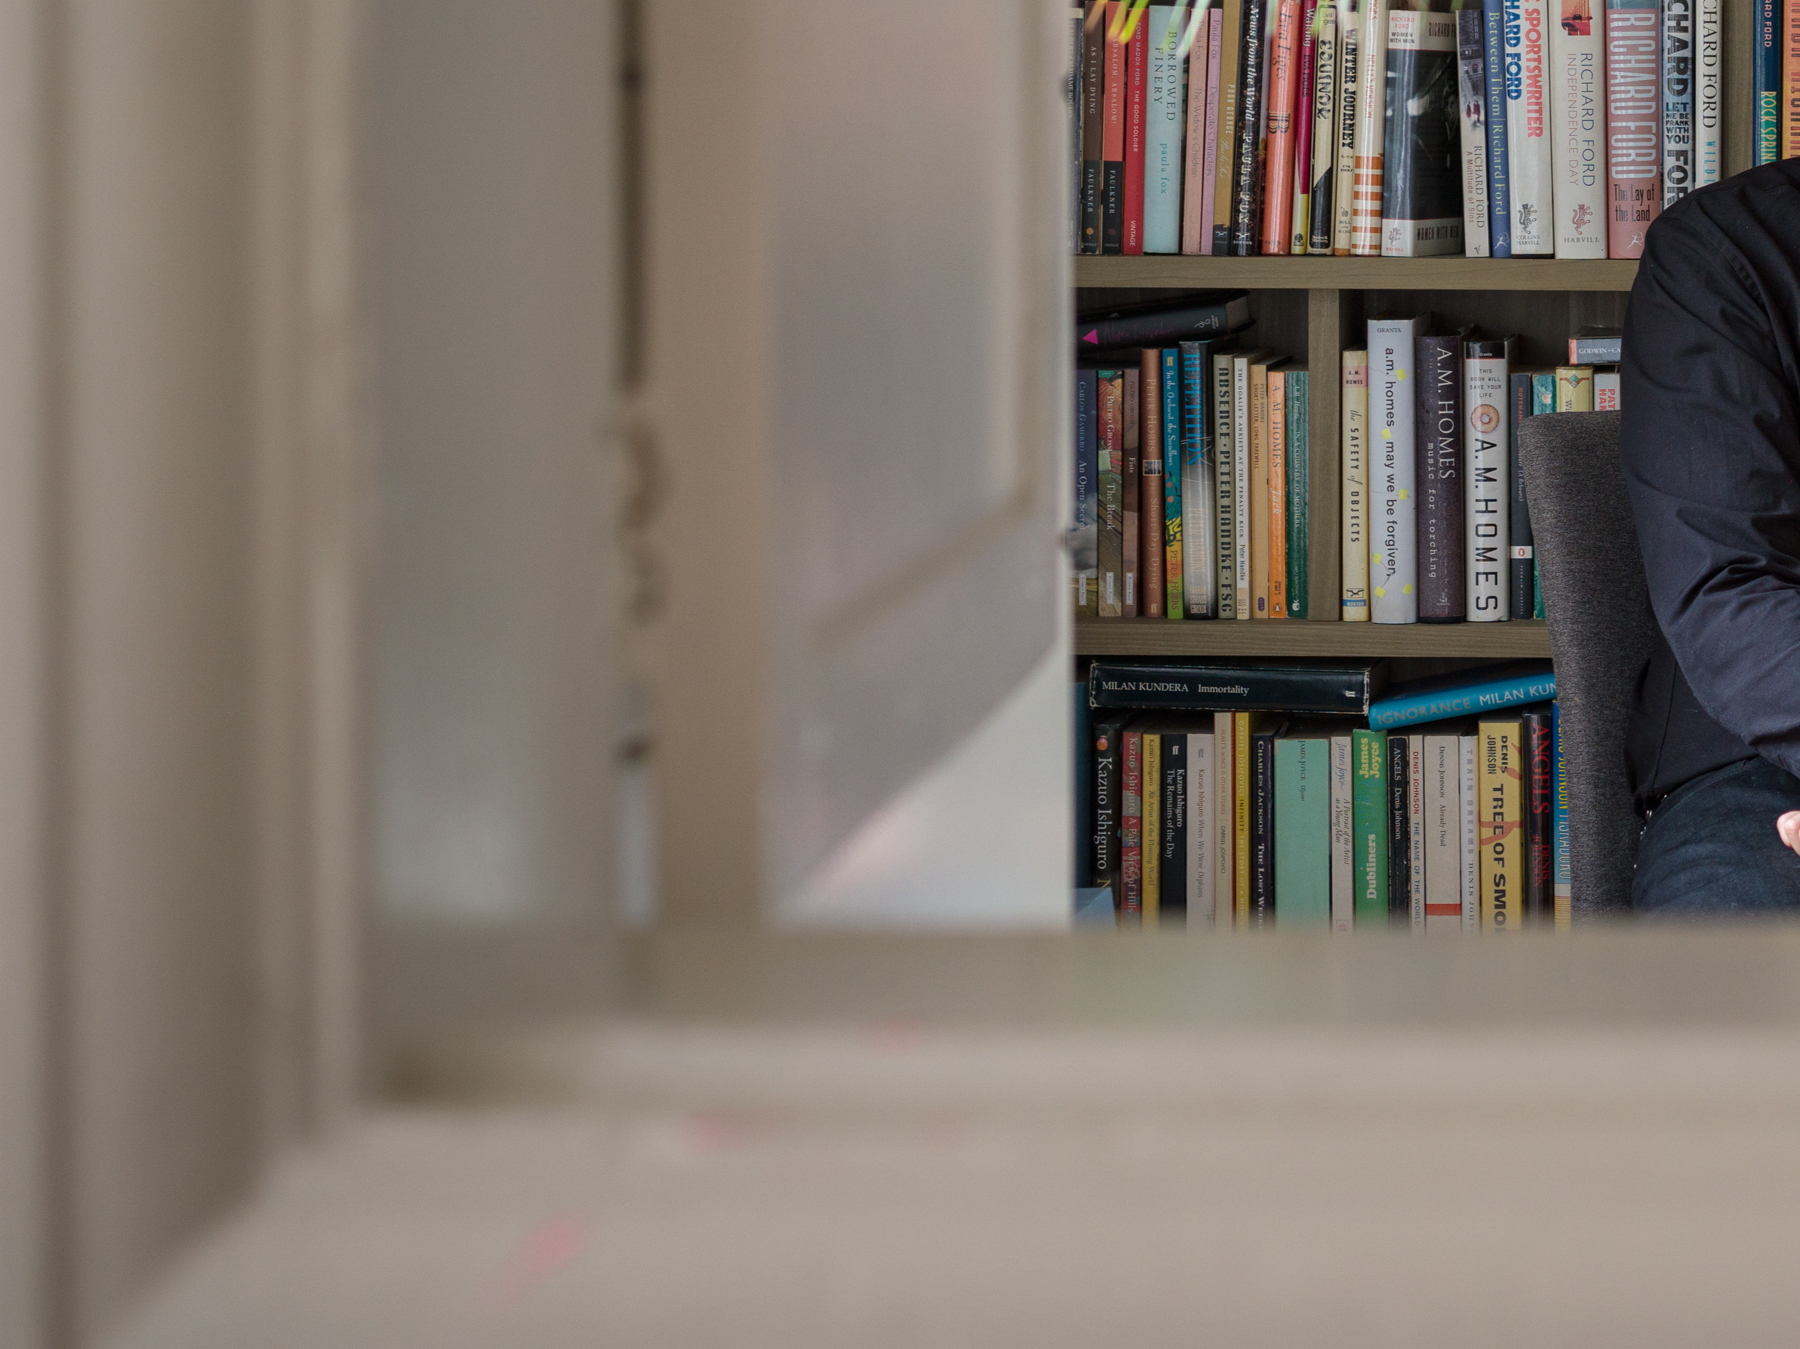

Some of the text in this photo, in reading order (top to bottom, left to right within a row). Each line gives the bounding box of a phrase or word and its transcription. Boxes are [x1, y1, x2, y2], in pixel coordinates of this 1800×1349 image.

[1154, 47, 1164, 105] FINERY
[1167, 30, 1177, 121] BORROWED
[1506, 52, 1522, 100] FORD
[1524, 9, 1543, 138] SPORTSWRITER
[1609, 12, 1657, 180] RICHARD FORD
[1701, 73, 1717, 129] FORD
[1567, 53, 1579, 186] INDEPENDENCE DAY
[1580, 52, 1596, 187] RICHARD FORD
[1614, 184, 1655, 204] The Lay of
[1615, 205, 1650, 222] the Land
[1437, 347, 1456, 479] A.M. HOMES
[1384, 347, 1397, 577] a.m. homes may we be forgiven,
[1475, 438, 1498, 611] A.M. HOMES
[1102, 681, 1250, 697] MILAN KUNDERA Immortality
[1359, 738, 1369, 778] James
[1370, 742, 1379, 778] Joyce
[1487, 735, 1497, 775] JOHNSON
[1094, 757, 1113, 870] Kazuo Ishiguro
[1492, 783, 1505, 868] TREE OF
[1366, 834, 1377, 899] Dubliners
